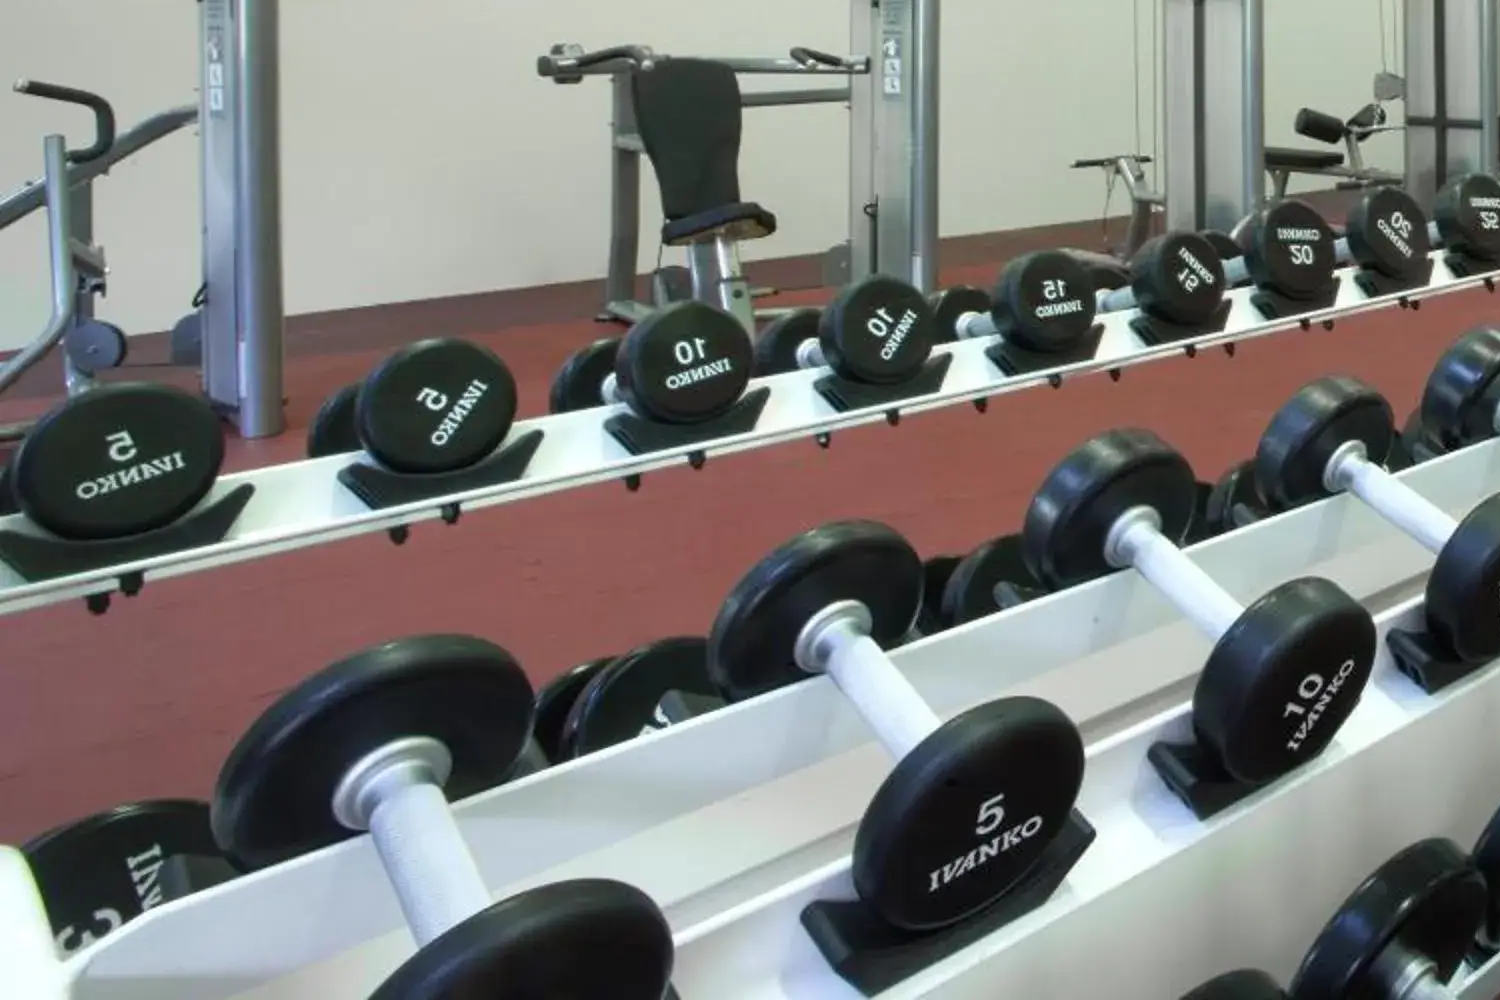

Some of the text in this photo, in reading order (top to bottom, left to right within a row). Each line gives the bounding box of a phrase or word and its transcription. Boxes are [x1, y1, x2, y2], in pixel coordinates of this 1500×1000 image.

[1283, 672, 1324, 718] 10
[1286, 658, 1355, 752] IVANKO
[975, 792, 1006, 836] 5
[927, 814, 1044, 893] IVANKO
